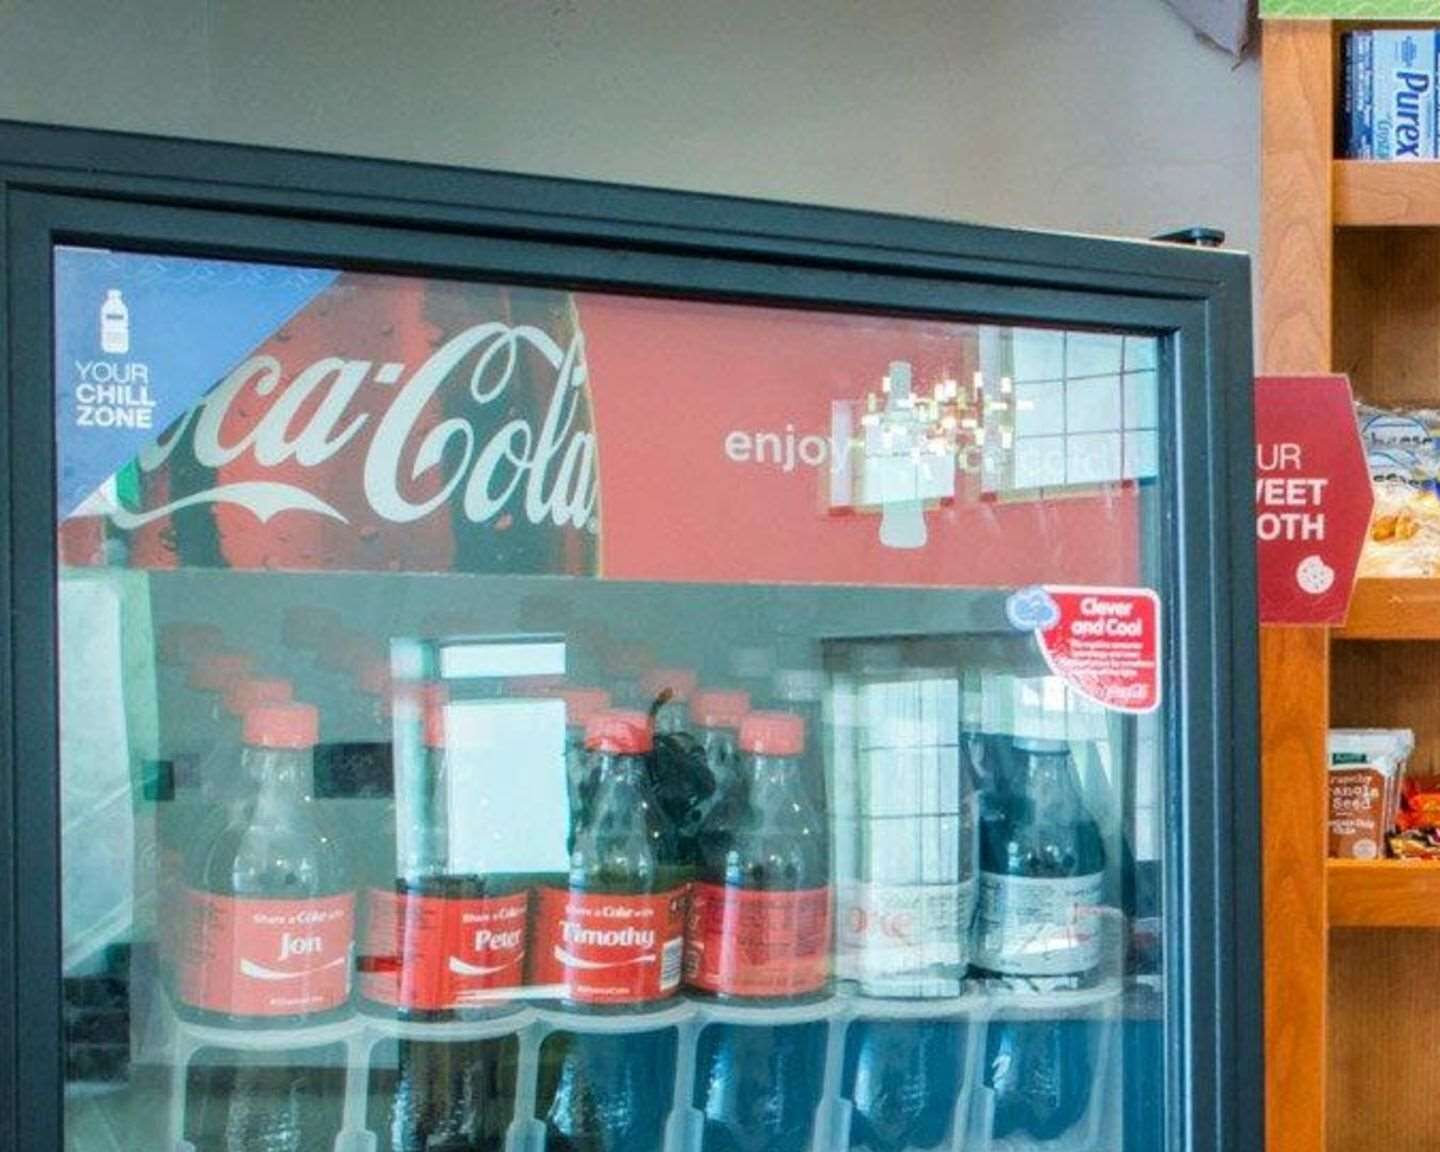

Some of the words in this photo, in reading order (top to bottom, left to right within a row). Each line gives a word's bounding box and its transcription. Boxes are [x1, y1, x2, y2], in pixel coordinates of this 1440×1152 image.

[1396, 71, 1430, 158] Purex
[75, 361, 149, 385] YOUR
[76, 382, 157, 407] CHILL
[76, 405, 152, 429] ZONE
[136, 320, 600, 534] ca-Cola
[1256, 443, 1302, 470] UR
[1255, 478, 1328, 506] EET
[1256, 513, 1326, 541] OTH
[1071, 618, 1104, 636] and
[1106, 618, 1143, 636] Cool
[278, 932, 321, 961] Jon
[558, 920, 656, 950] Timothy
